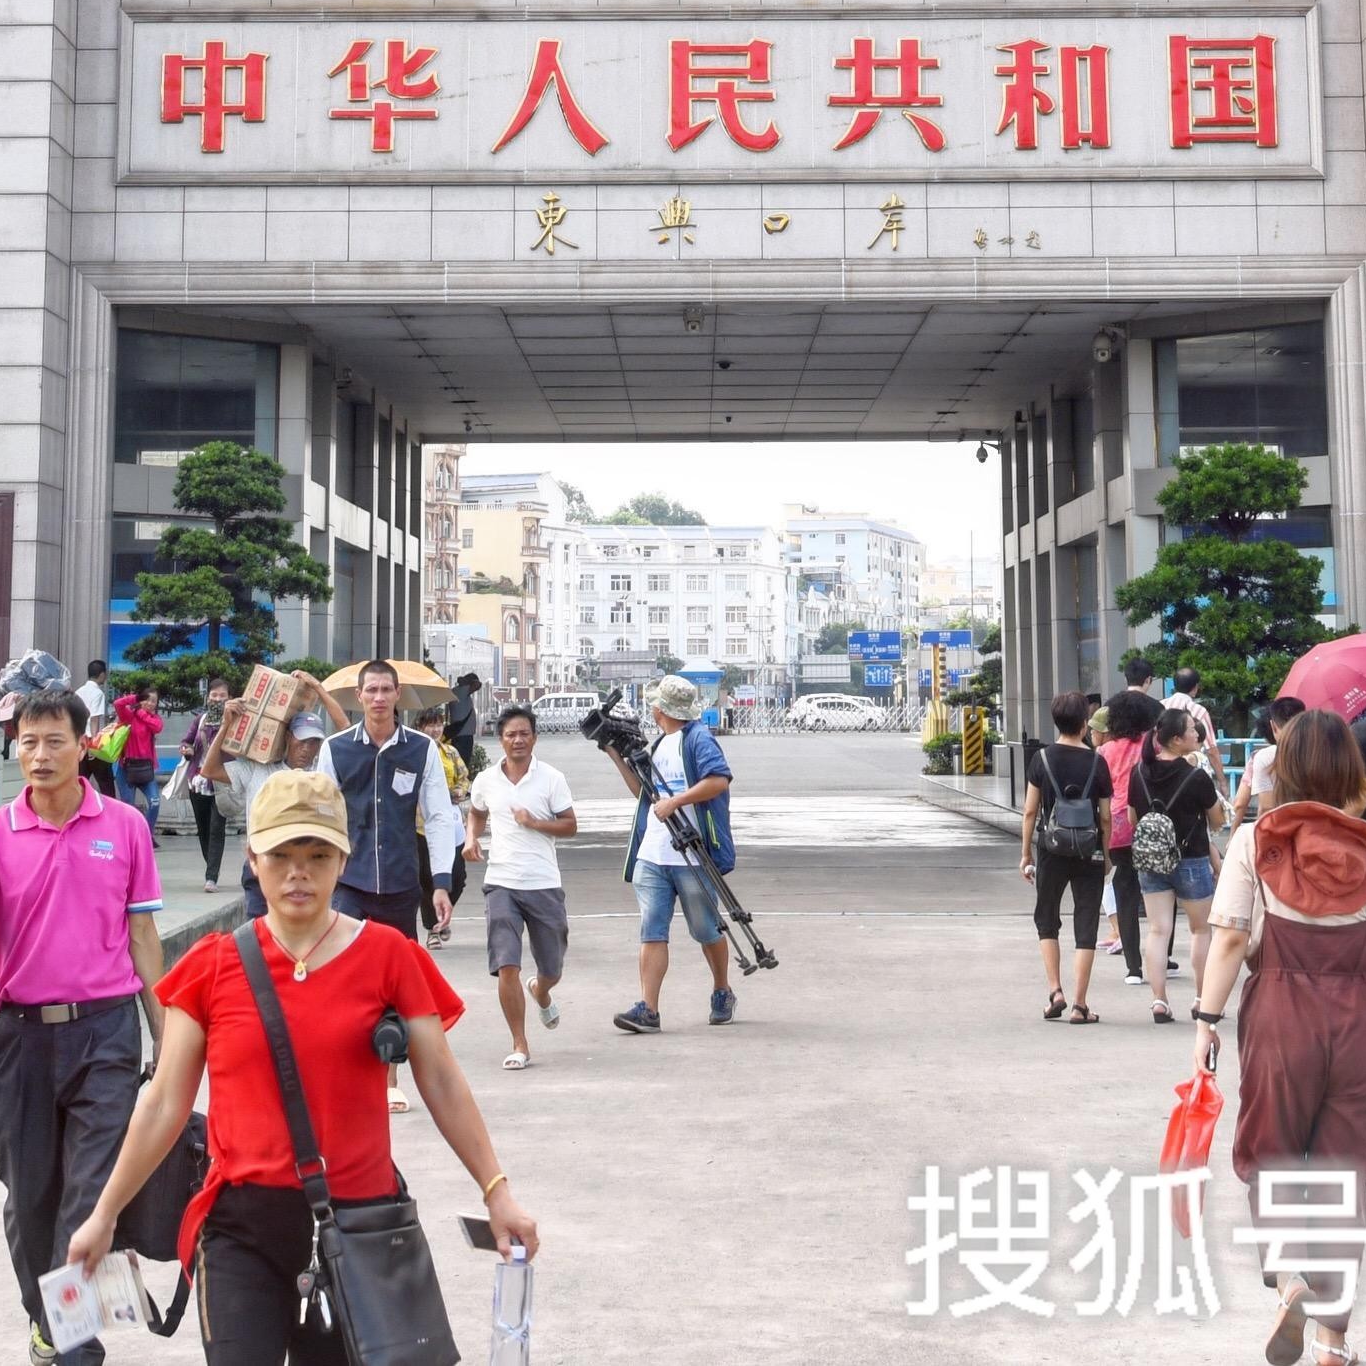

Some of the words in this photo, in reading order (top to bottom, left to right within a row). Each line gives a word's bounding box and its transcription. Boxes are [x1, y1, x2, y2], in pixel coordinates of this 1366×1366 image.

[161, 33, 1280, 156] 中华人民共和国
